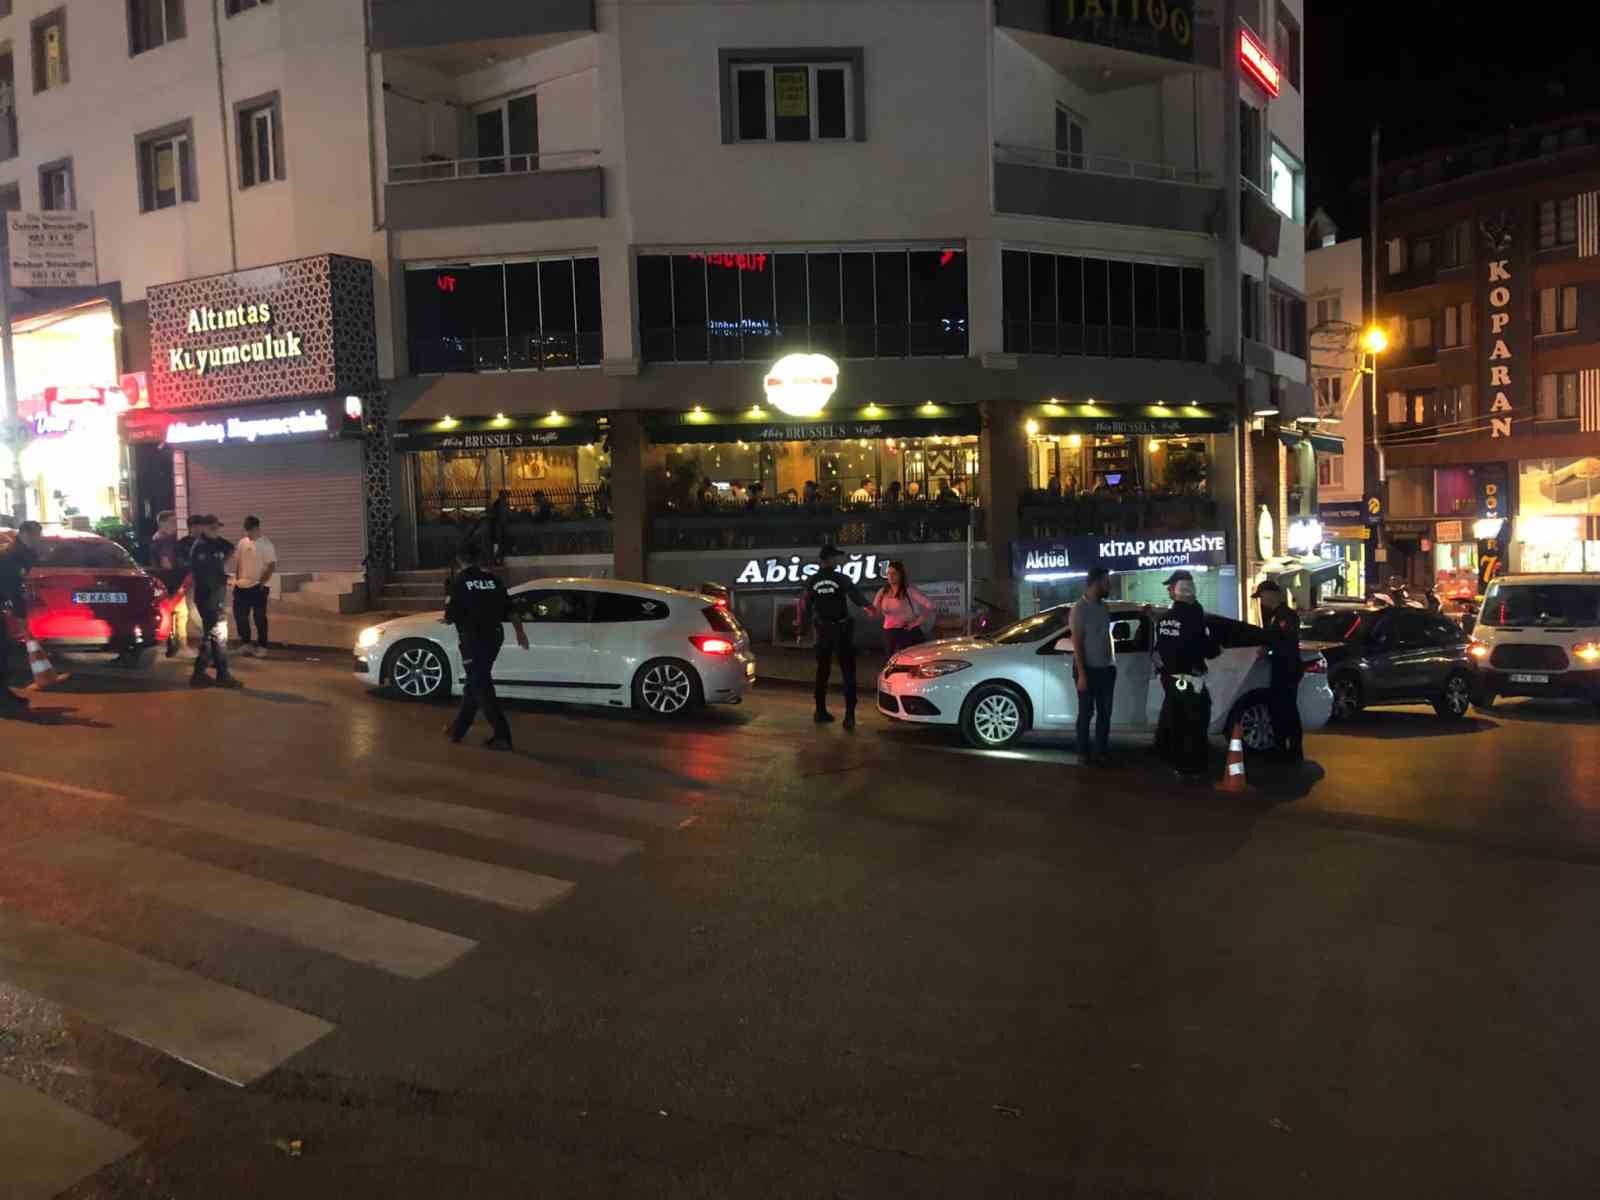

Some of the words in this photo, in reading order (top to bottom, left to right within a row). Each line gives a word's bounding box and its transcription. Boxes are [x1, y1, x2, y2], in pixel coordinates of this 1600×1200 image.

[1488, 260, 1512, 438] KOPARAN
[1099, 539, 1146, 558] KİTAP
[1149, 533, 1225, 555] KIRTASİYE
[1025, 549, 1070, 569] Aktüel
